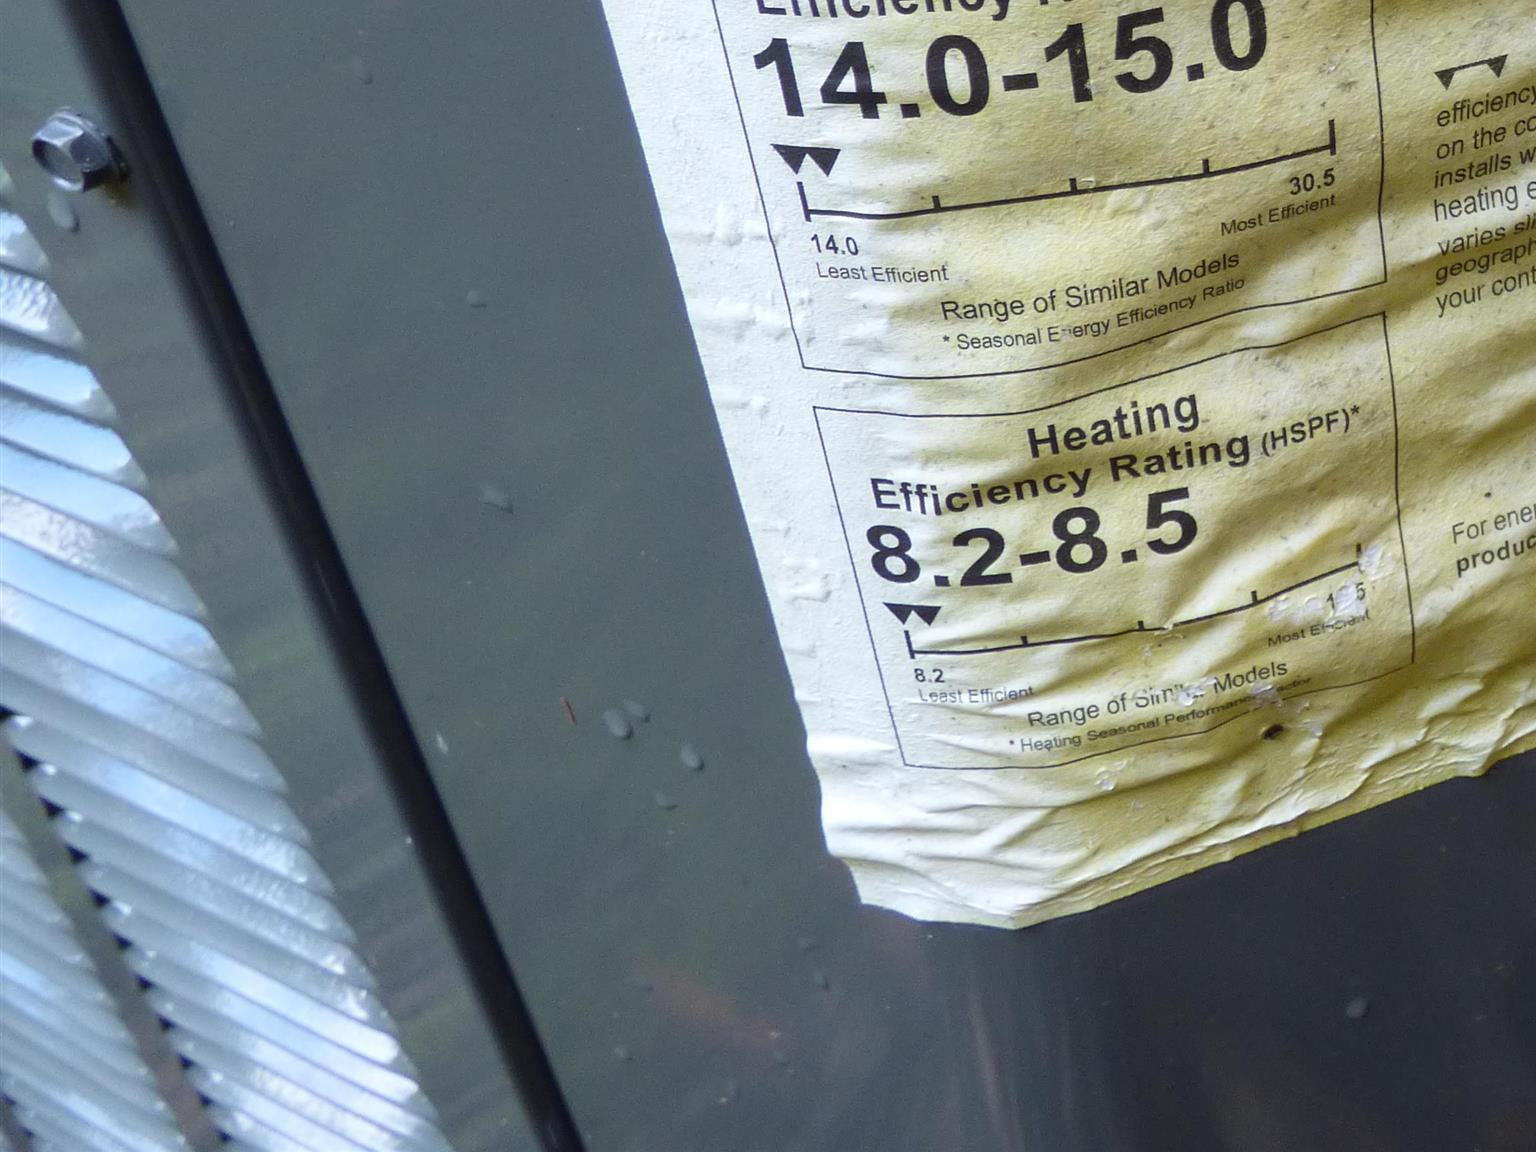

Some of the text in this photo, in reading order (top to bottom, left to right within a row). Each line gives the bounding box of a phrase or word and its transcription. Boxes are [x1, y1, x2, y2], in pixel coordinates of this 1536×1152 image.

[1436, 139, 1464, 160] on
[1472, 125, 1507, 148] the
[1434, 153, 1512, 189] installs
[810, 168, 1336, 256] 14.0 30.5
[1220, 193, 1336, 236] Most Efficient
[1434, 181, 1520, 222] heating
[1438, 226, 1507, 257] varies
[816, 260, 949, 284] Least Efficient
[941, 251, 1240, 323] Range of Similar Models
[956, 327, 1044, 350] Seasonal
[1116, 294, 1200, 328] Efficiency
[1202, 276, 1246, 302] Ratio
[1435, 283, 1485, 318] your
[1027, 392, 1201, 459] Heating
[871, 465, 1093, 517] Efficiency
[1111, 431, 1250, 484] Rating
[865, 486, 1198, 588] 8.2-8.5
[1452, 521, 1487, 544] For
[1268, 629, 1306, 647] Most
[914, 668, 945, 683] 8.2
[918, 686, 1033, 703] Least Efficient
[1027, 704, 1100, 728] Range
[1106, 694, 1127, 714] of
[1213, 662, 1288, 694] Models
[1020, 733, 1082, 753] Heating
[1087, 720, 1160, 741] Seasonal
